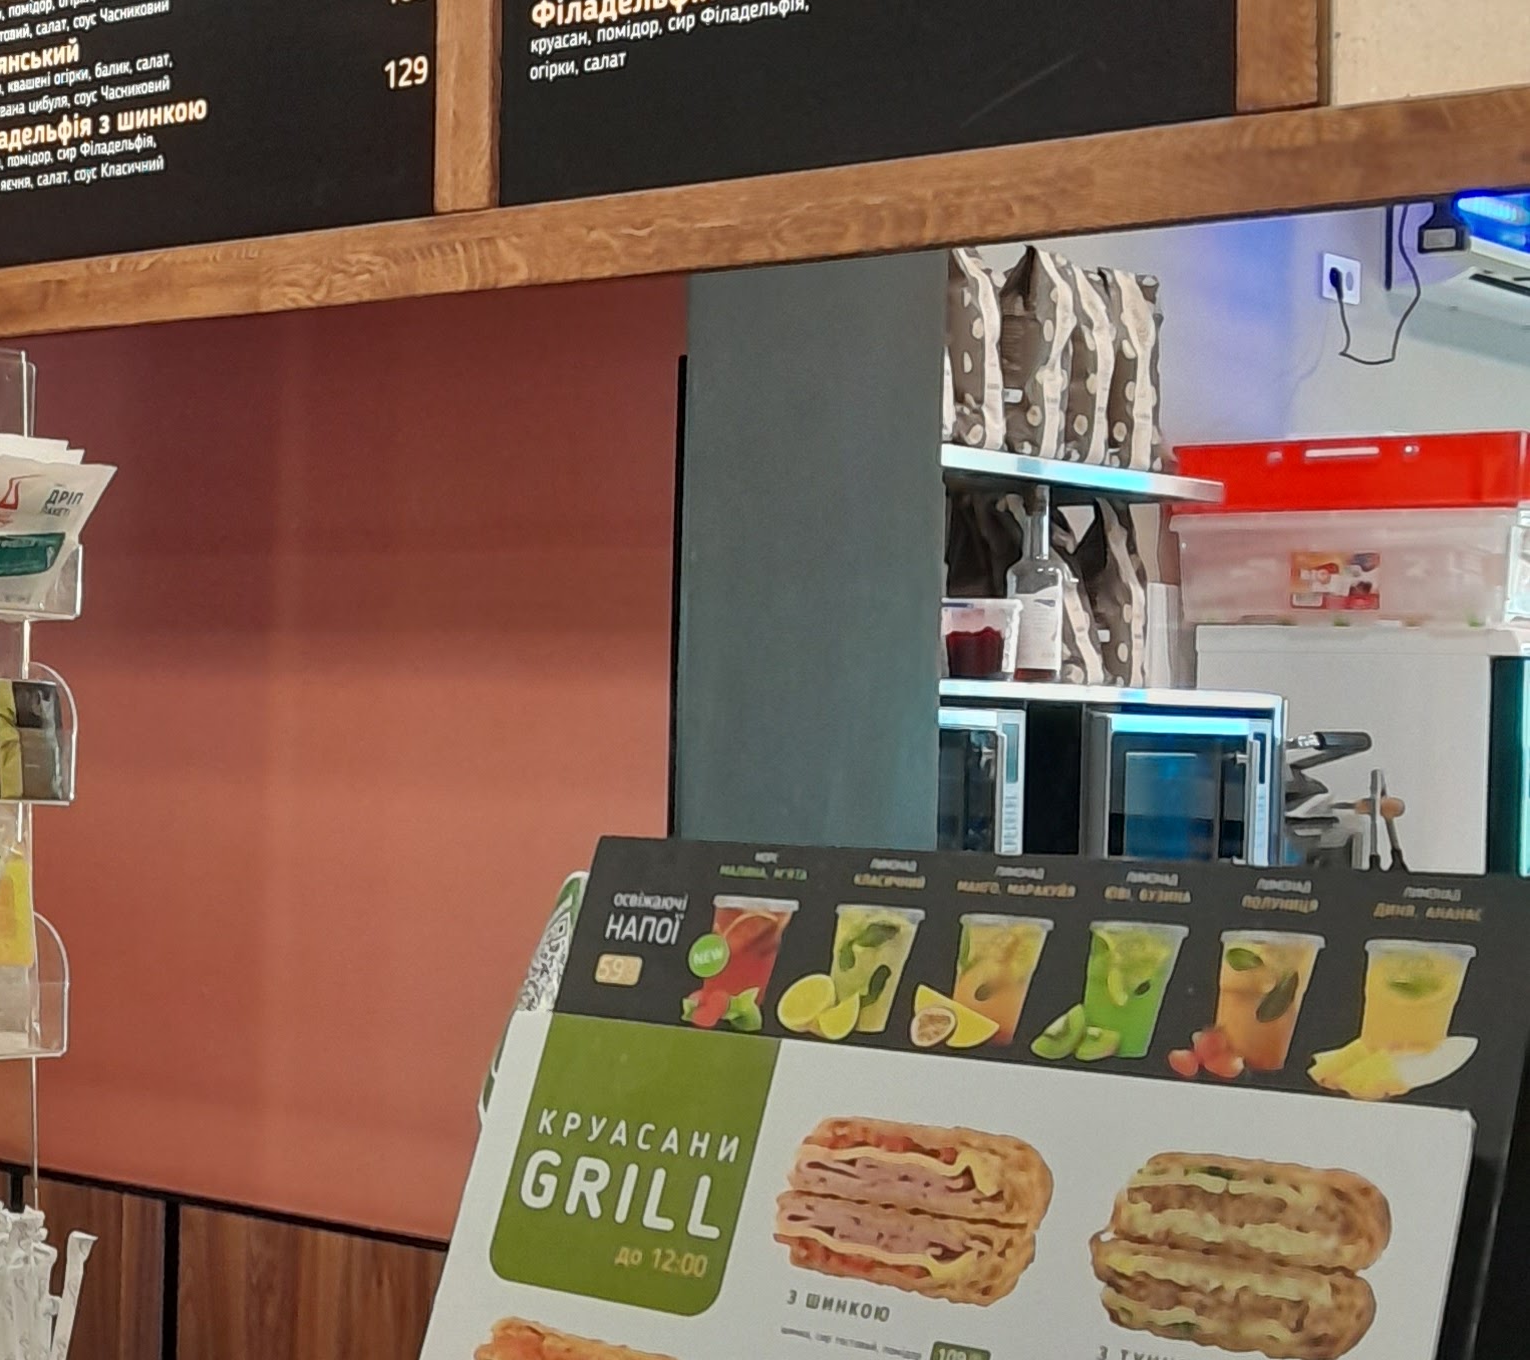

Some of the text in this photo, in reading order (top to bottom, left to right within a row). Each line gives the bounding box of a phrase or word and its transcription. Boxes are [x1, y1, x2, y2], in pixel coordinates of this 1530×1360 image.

[384, 55, 429, 89] 129
[98, 114, 110, 135] з
[117, 99, 207, 132] шинкою
[46, 489, 84, 506] ДРІП
[613, 892, 689, 911] освіжаючі
[604, 913, 680, 945] НАПОЇ
[598, 957, 625, 977] 59
[693, 946, 723, 966] NEW
[538, 1108, 740, 1163] КРУАСАНИ
[520, 1149, 720, 1239] GRILL
[614, 1246, 708, 1278] до 12:00
[786, 1289, 891, 1323] З ШИНКОЮ
